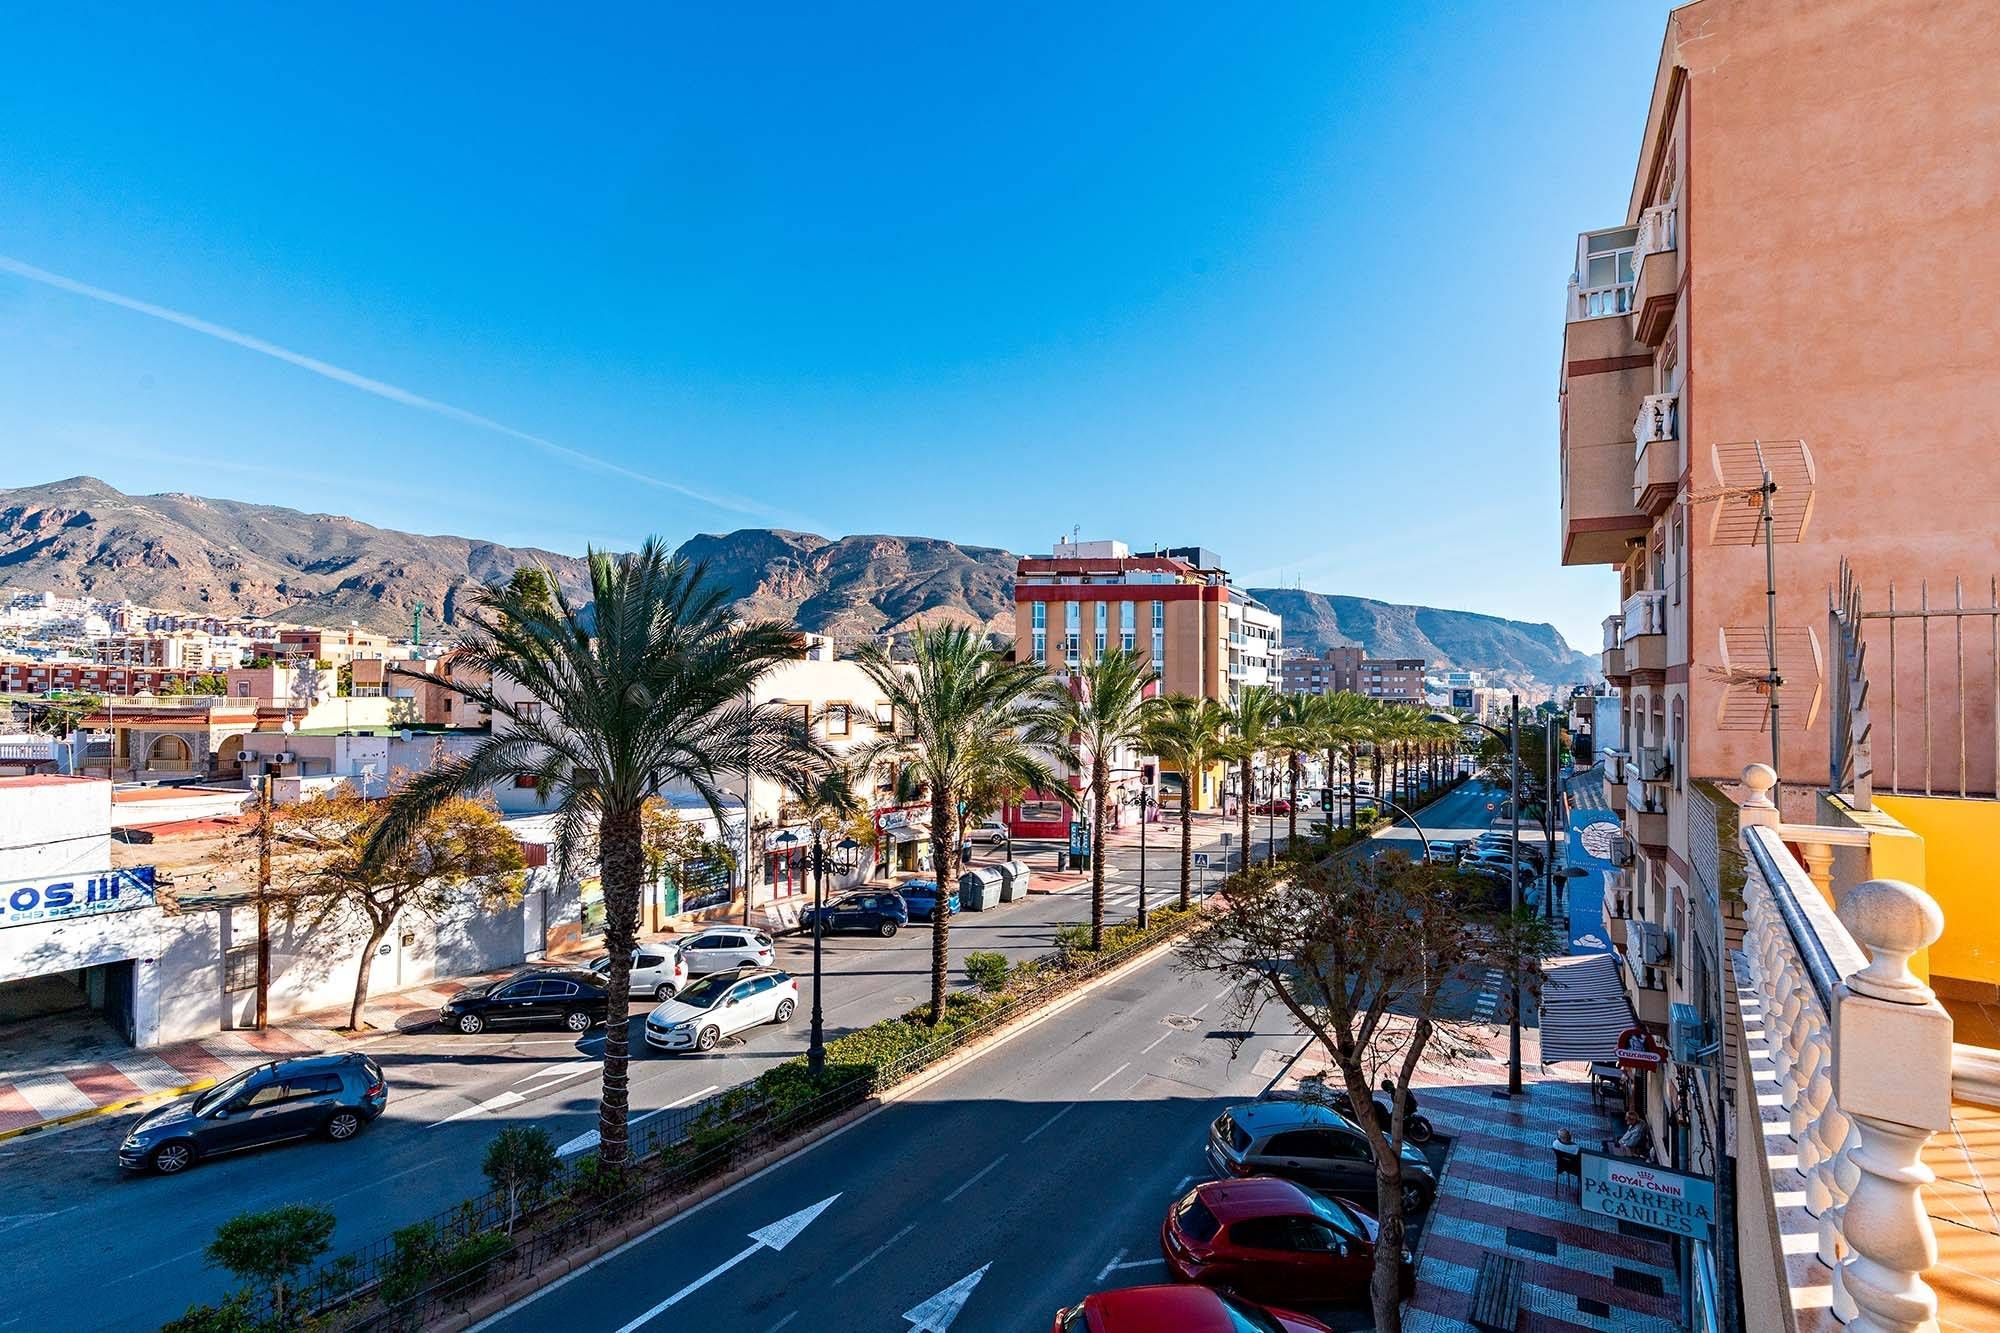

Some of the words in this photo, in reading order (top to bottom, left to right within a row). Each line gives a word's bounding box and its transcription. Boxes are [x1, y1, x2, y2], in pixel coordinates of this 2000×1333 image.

[0, 882, 73, 914] OS
[1618, 1050, 1658, 1061] Cruzcampo
[1584, 1177, 1711, 1221] PAJARERIA
[1611, 1173, 1644, 1188] ROYAL
[1646, 1182, 1681, 1196] CANIN
[1602, 1198, 1692, 1233] CANILES
